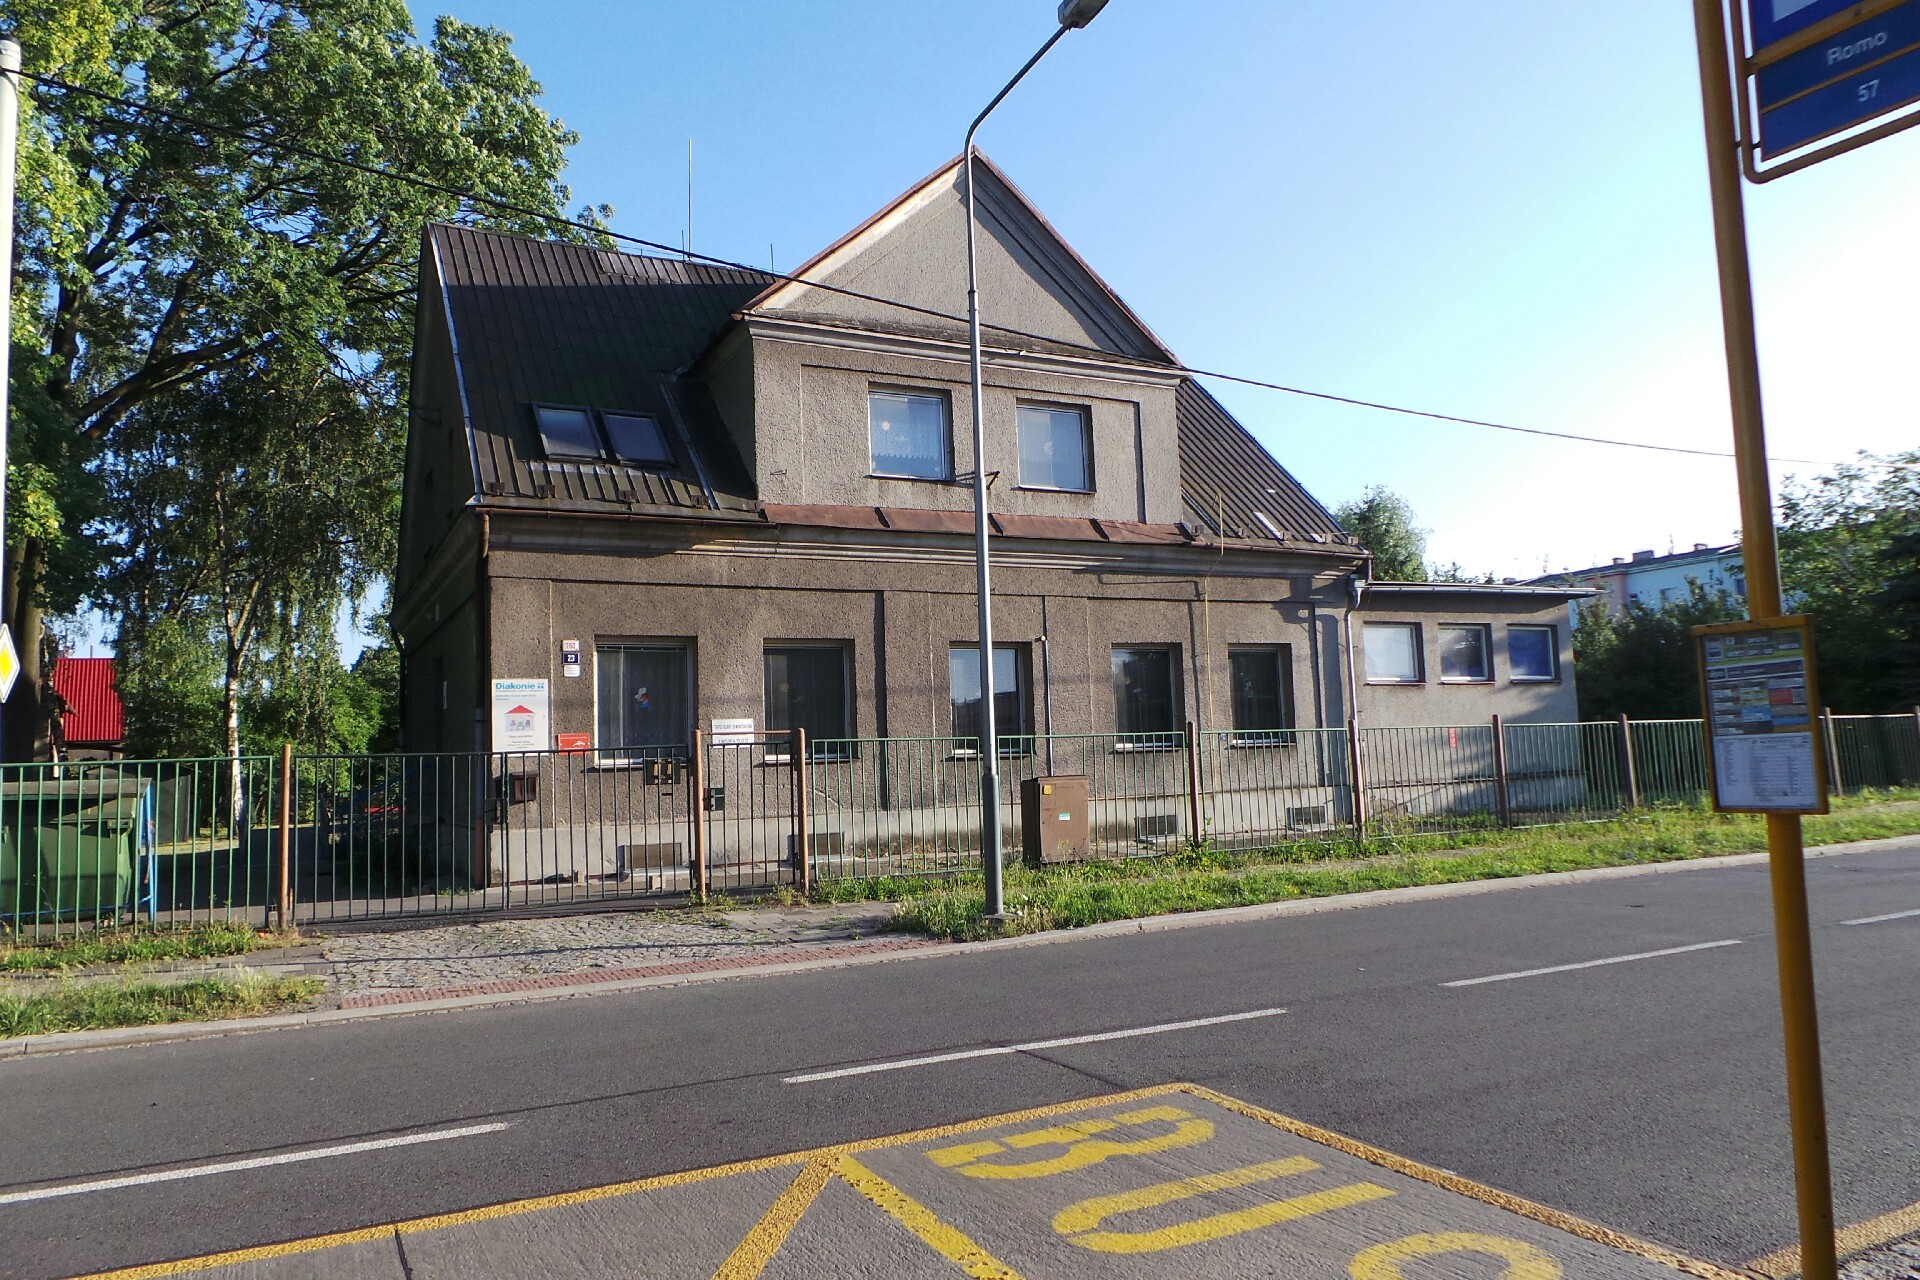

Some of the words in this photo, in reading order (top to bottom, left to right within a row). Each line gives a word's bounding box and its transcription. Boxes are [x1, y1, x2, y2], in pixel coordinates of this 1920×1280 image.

[1827, 32, 1887, 65] Romo
[1858, 79, 1879, 102] 57
[567, 654, 576, 662] 23
[495, 682, 536, 690] Diakonie
